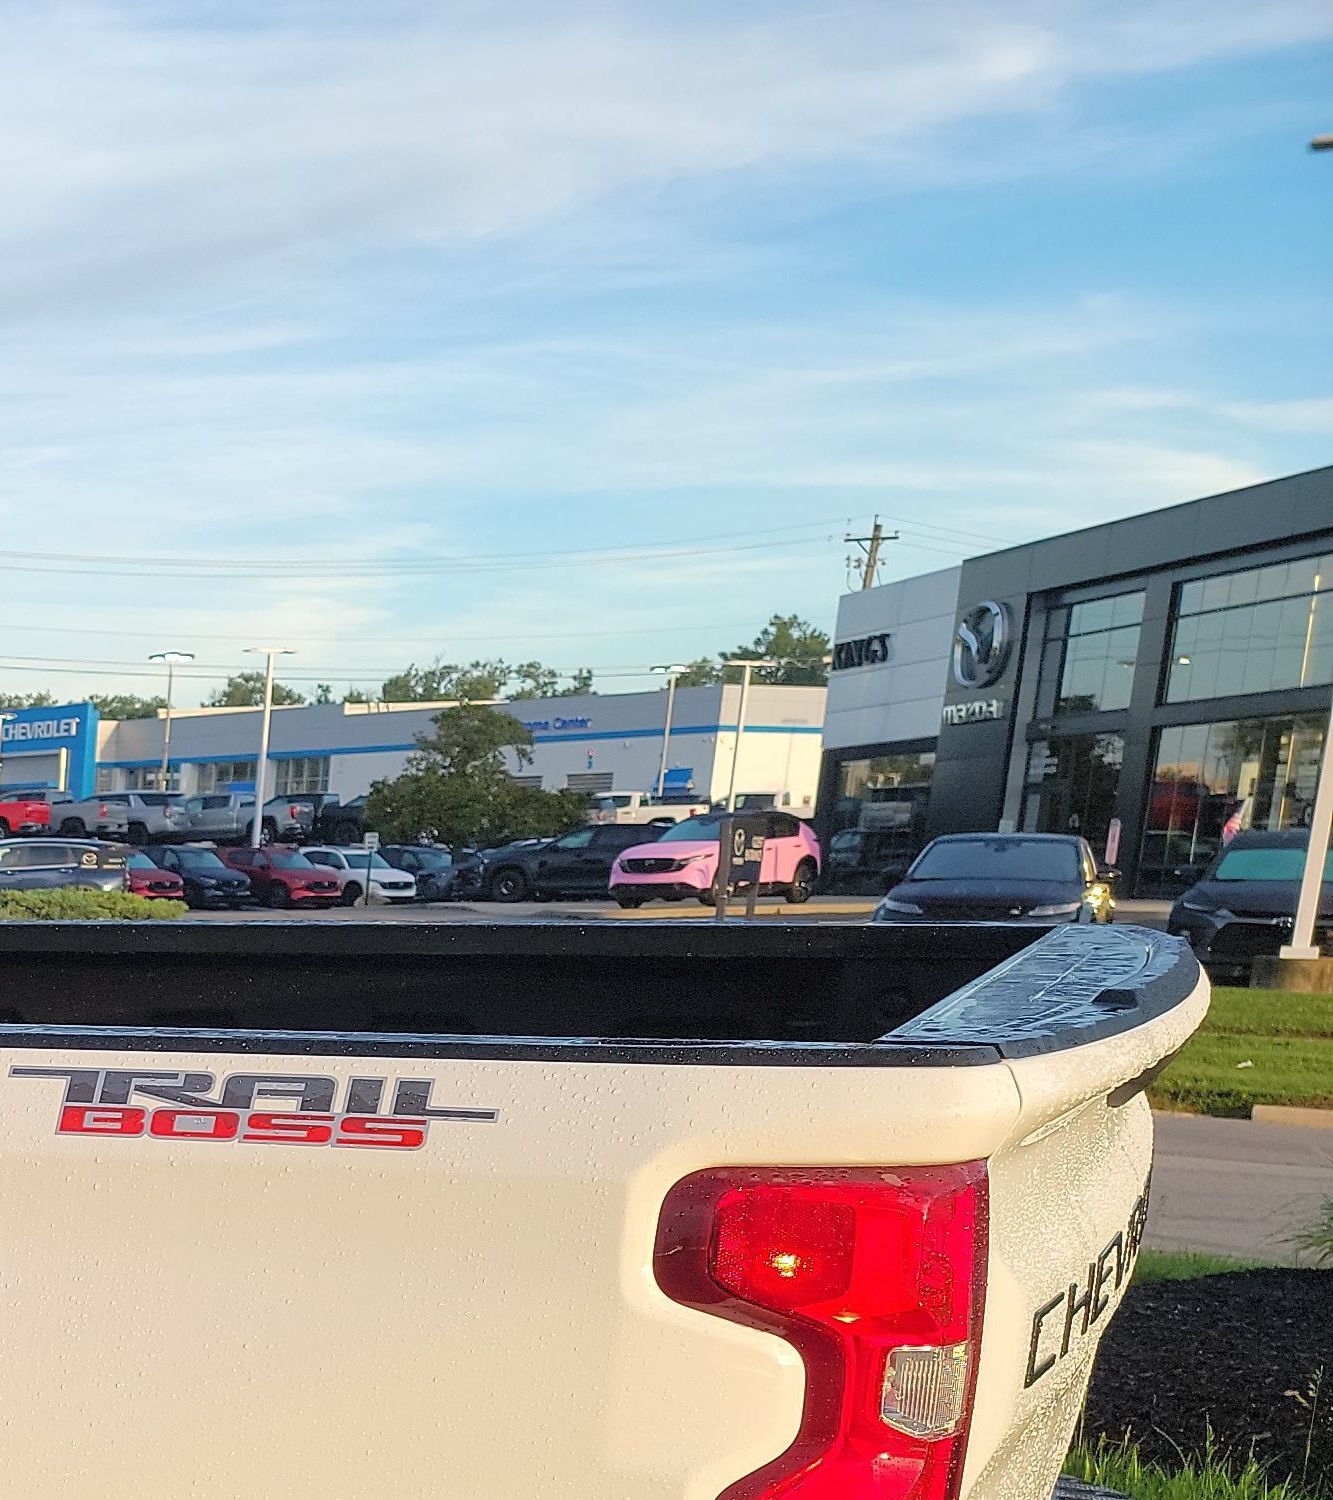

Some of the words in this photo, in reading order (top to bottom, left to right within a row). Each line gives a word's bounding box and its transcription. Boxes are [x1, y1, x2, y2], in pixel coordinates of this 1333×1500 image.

[2, 716, 80, 742] CHEVROLET
[7, 1064, 499, 1123] TRAIL
[54, 1103, 433, 1150] BOSS
